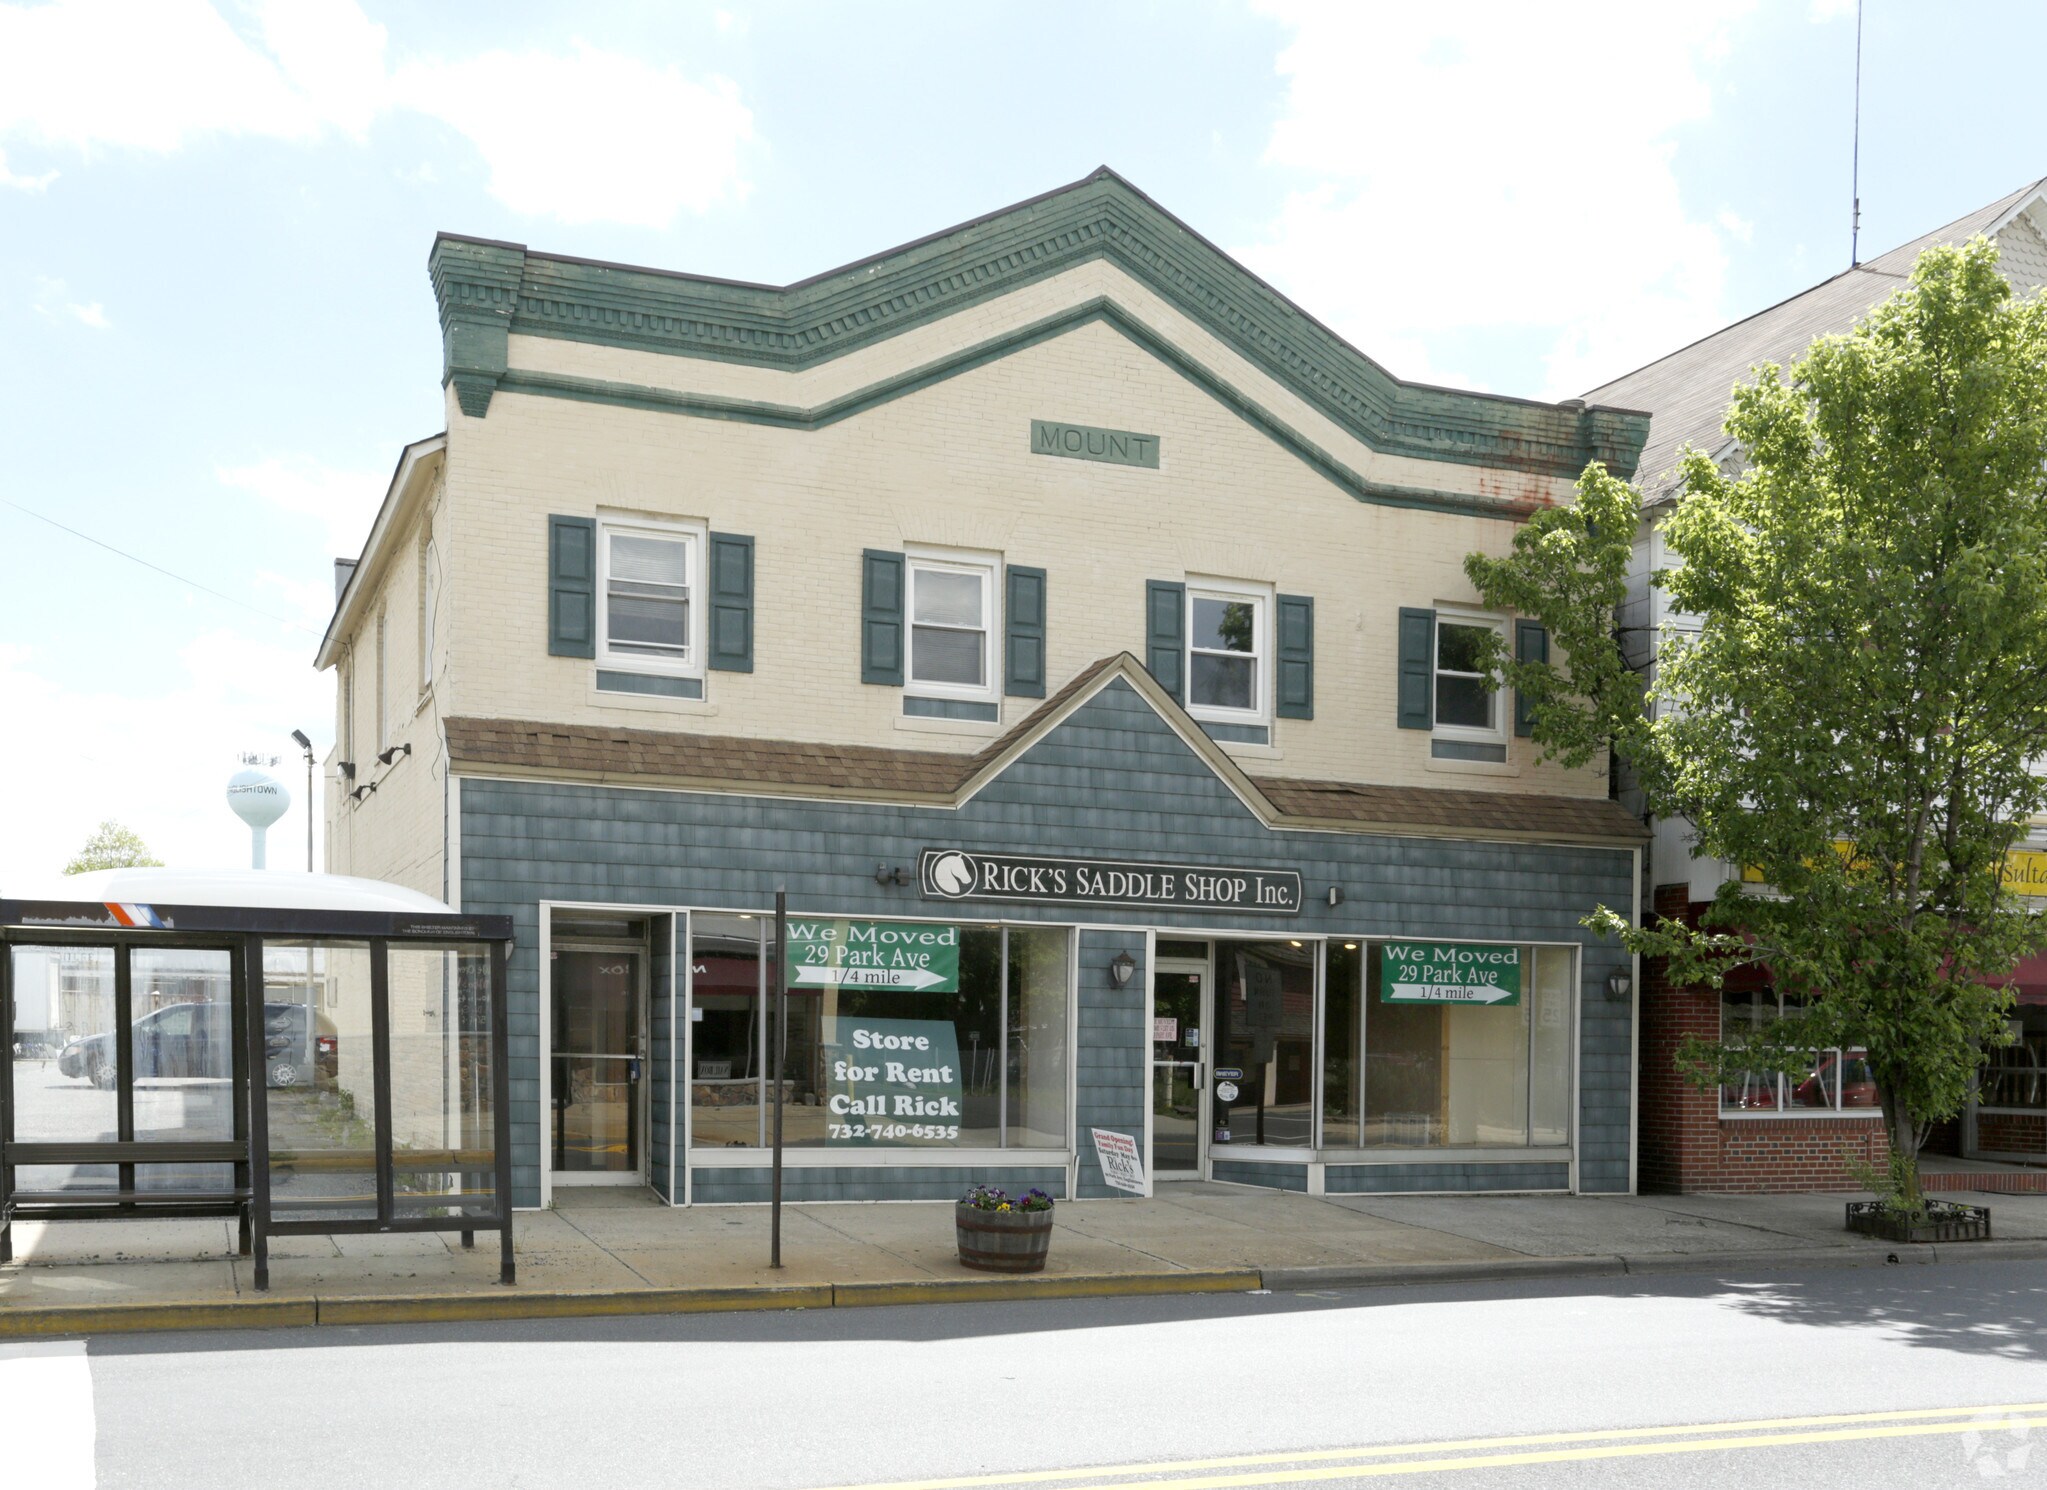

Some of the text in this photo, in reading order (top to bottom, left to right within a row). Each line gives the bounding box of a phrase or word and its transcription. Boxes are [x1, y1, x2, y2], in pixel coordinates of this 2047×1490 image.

[1041, 425, 1151, 460] MOUNT
[982, 862, 1293, 905] RICK'S SADDLE SHOP Inc.
[786, 923, 957, 946] We Moved
[804, 944, 930, 968] 29 Park Ave
[1384, 945, 1519, 965] We Moved
[832, 967, 900, 984] 1/4 mile
[1398, 963, 1498, 984] 29 Park Ave
[1421, 984, 1474, 1000] 1/4 mile
[852, 1029, 929, 1050] Store
[834, 1060, 953, 1084] for Rent
[830, 1094, 959, 1116] Call Rick
[828, 1123, 958, 1140] 732-740-6535
[1094, 1132, 1110, 1141] Grand
[1098, 1148, 1119, 1158] Saturday
[1120, 1152, 1130, 1160] May
[1124, 1146, 1134, 1154] Day
[1106, 1156, 1134, 1174] Rick's
